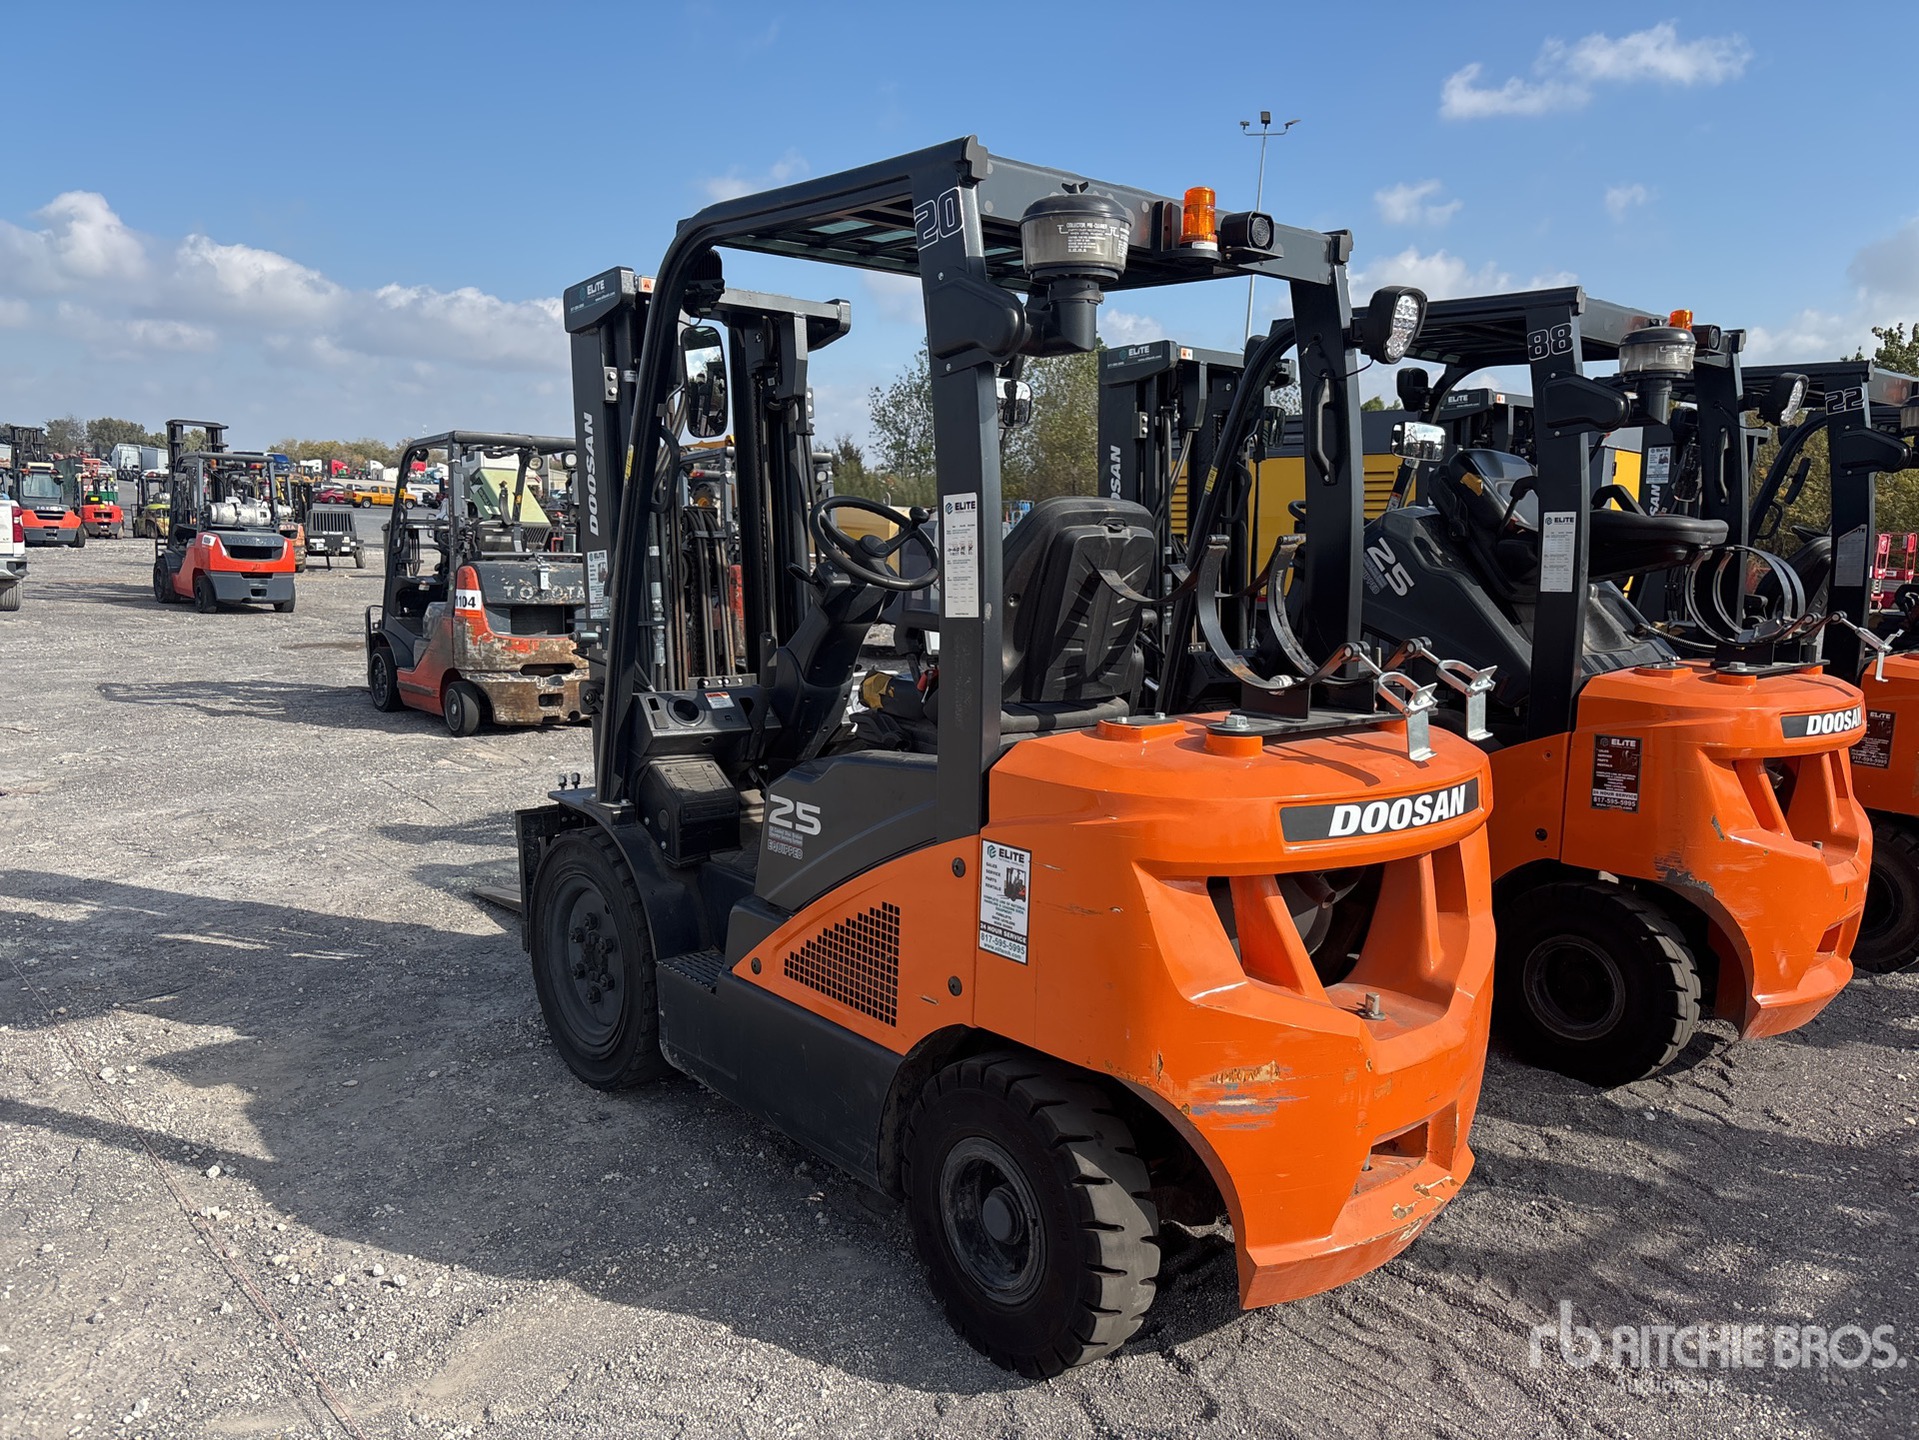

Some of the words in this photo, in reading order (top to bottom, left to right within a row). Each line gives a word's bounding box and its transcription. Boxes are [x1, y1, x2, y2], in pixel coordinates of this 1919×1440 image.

[914, 186, 964, 251] 20
[587, 280, 605, 295] ELITE
[1128, 346, 1150, 356] ELITE
[1527, 322, 1573, 361] 88
[1448, 394, 1468, 403] ELITE
[1825, 386, 1864, 415] 22
[584, 412, 599, 536] DOOSAN
[955, 501, 976, 510] ELITE
[1367, 537, 1414, 596] 25
[1611, 738, 1636, 747] ELITE
[769, 794, 821, 835] 25
[1328, 784, 1466, 837] DOOSAN
[999, 847, 1024, 863] ELITE
[980, 932, 1024, 955] 817-595-5995
[987, 925, 1002, 935] HOUR
[1004, 930, 1026, 944] SERVICE
